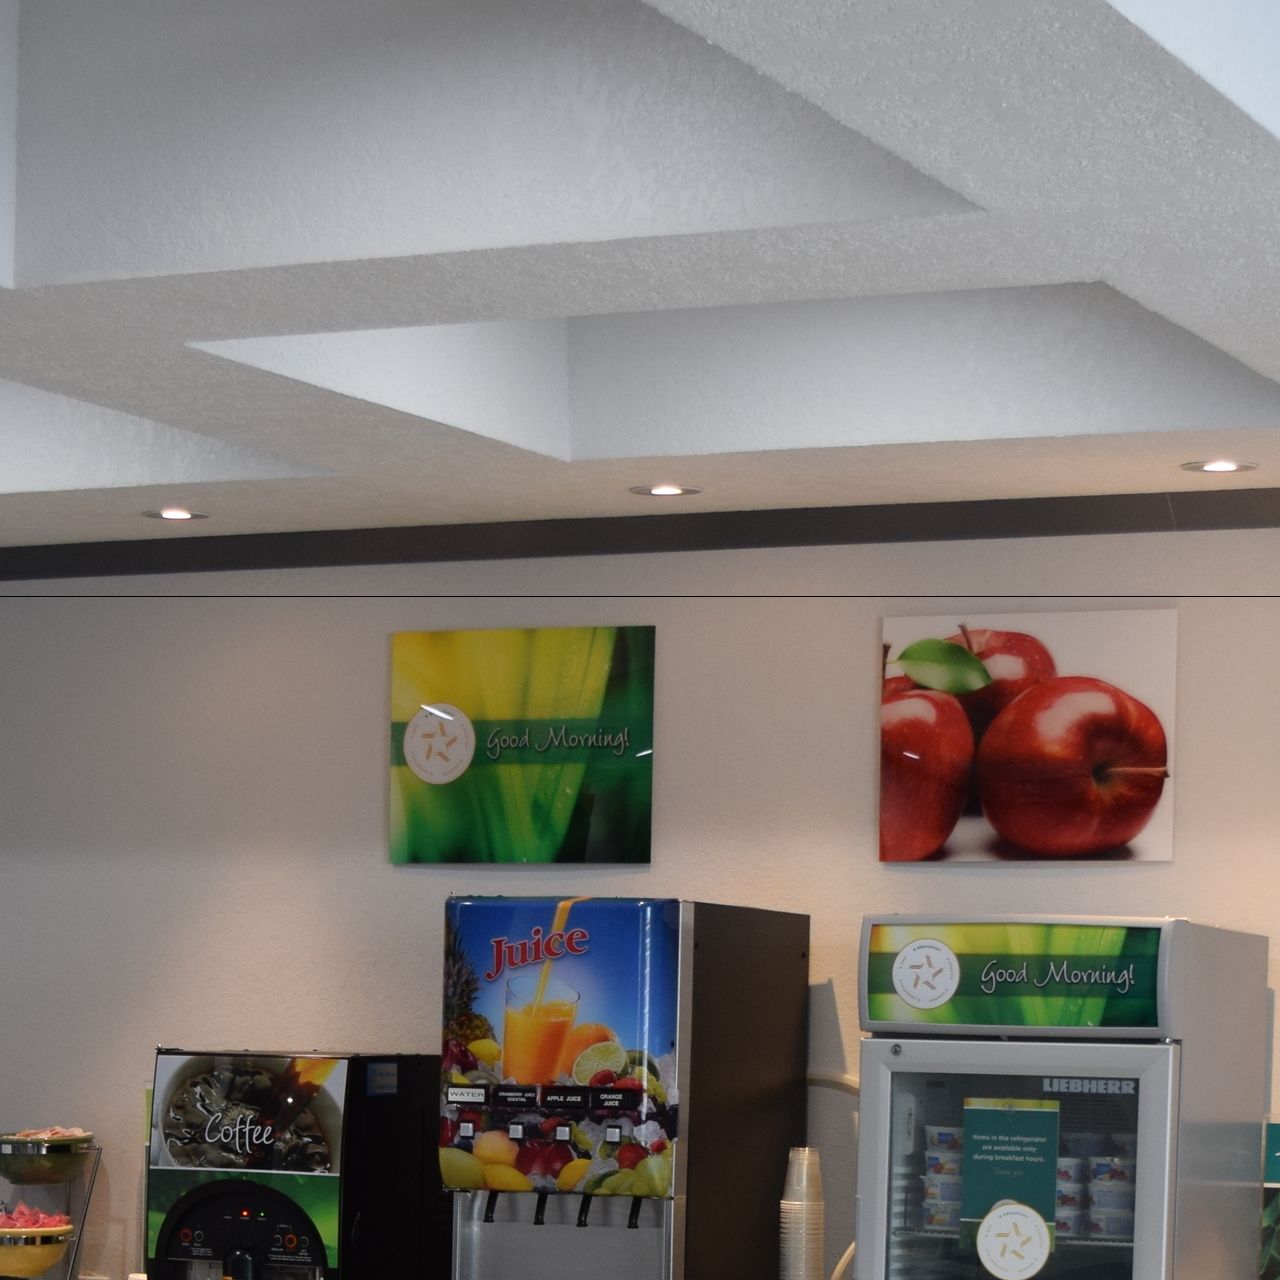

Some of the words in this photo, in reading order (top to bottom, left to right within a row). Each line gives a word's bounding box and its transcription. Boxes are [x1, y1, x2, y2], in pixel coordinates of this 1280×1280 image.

[486, 727, 529, 760] Good
[535, 726, 630, 757] Morning!
[485, 926, 589, 982] Juice
[980, 960, 1028, 994] Good
[1033, 960, 1136, 994] Morning!
[1042, 1078, 1136, 1095] LIEBHERR
[204, 1112, 274, 1154] Coffee
